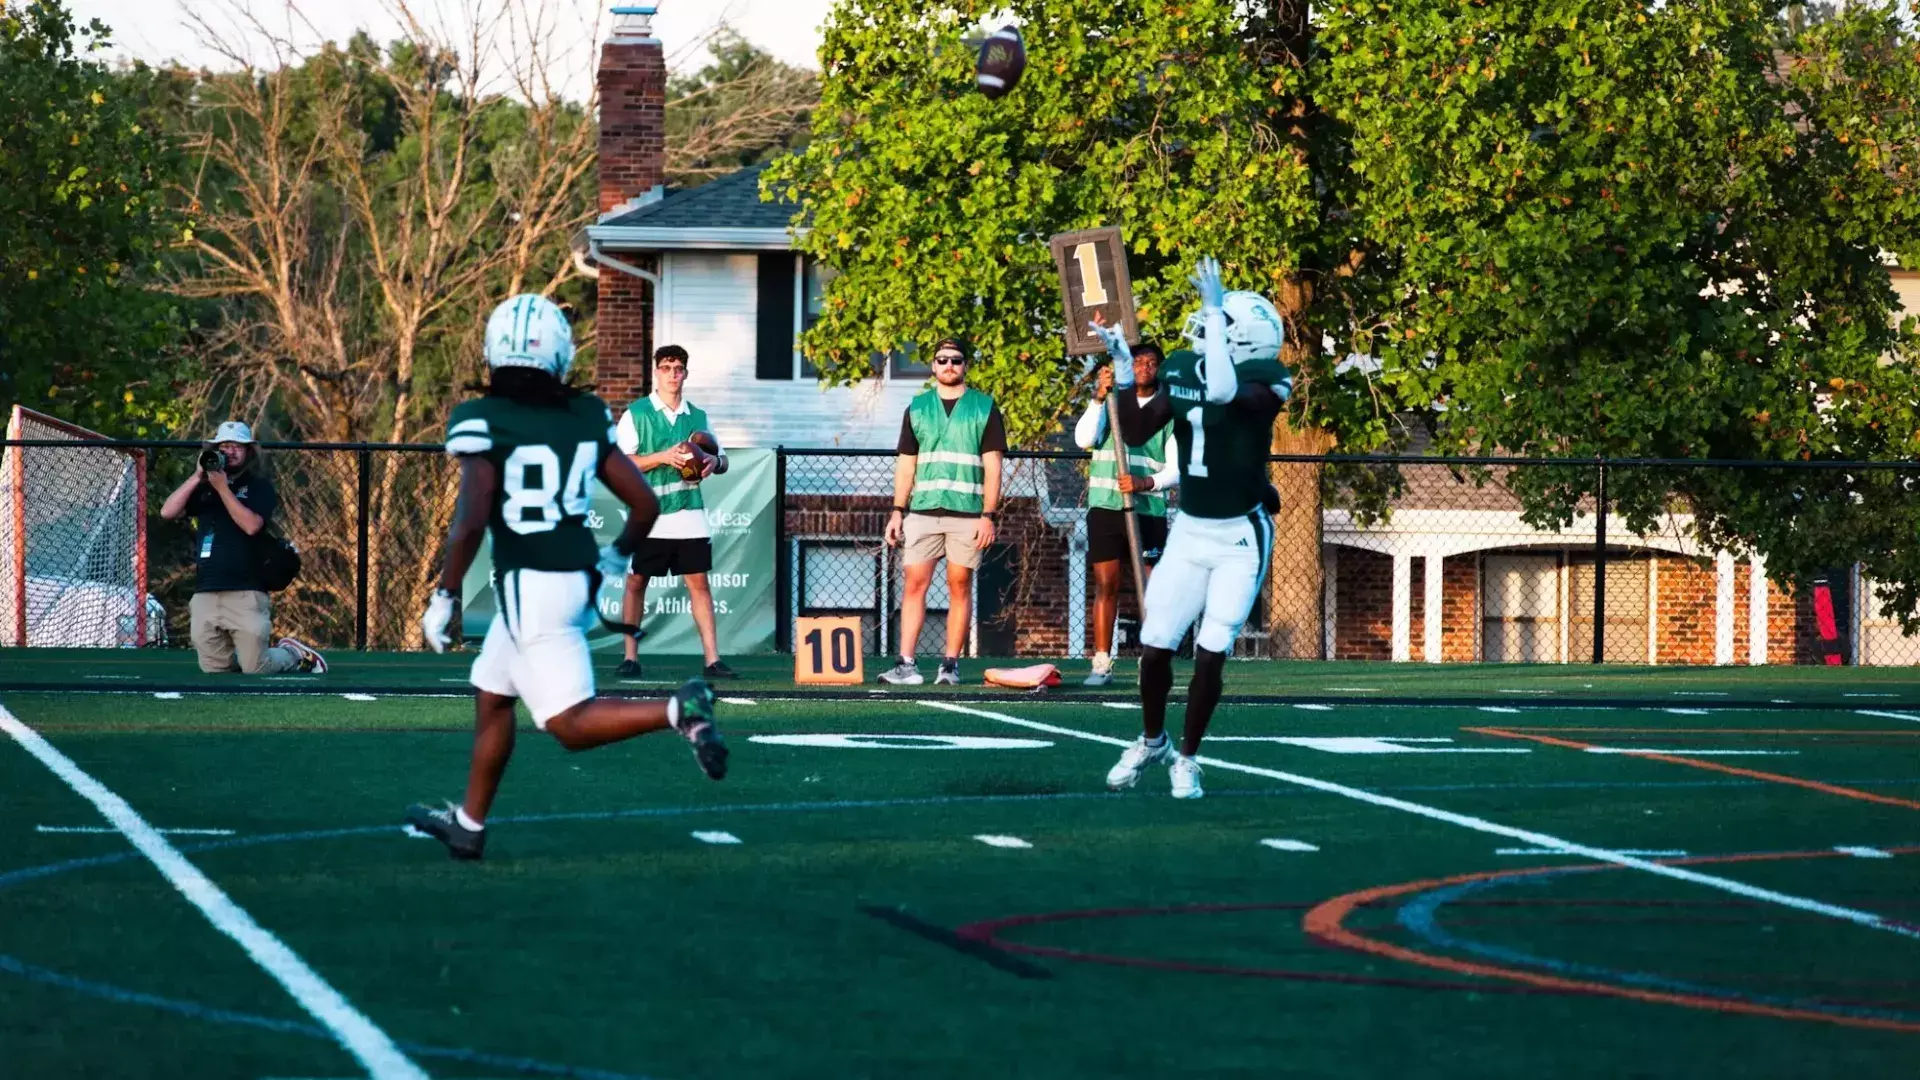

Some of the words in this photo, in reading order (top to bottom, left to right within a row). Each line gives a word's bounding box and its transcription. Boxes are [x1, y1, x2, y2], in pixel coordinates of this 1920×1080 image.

[1073, 242, 1108, 307] 1
[1186, 406, 1208, 478] 1
[502, 441, 599, 535] 84
[804, 627, 856, 674] 10
